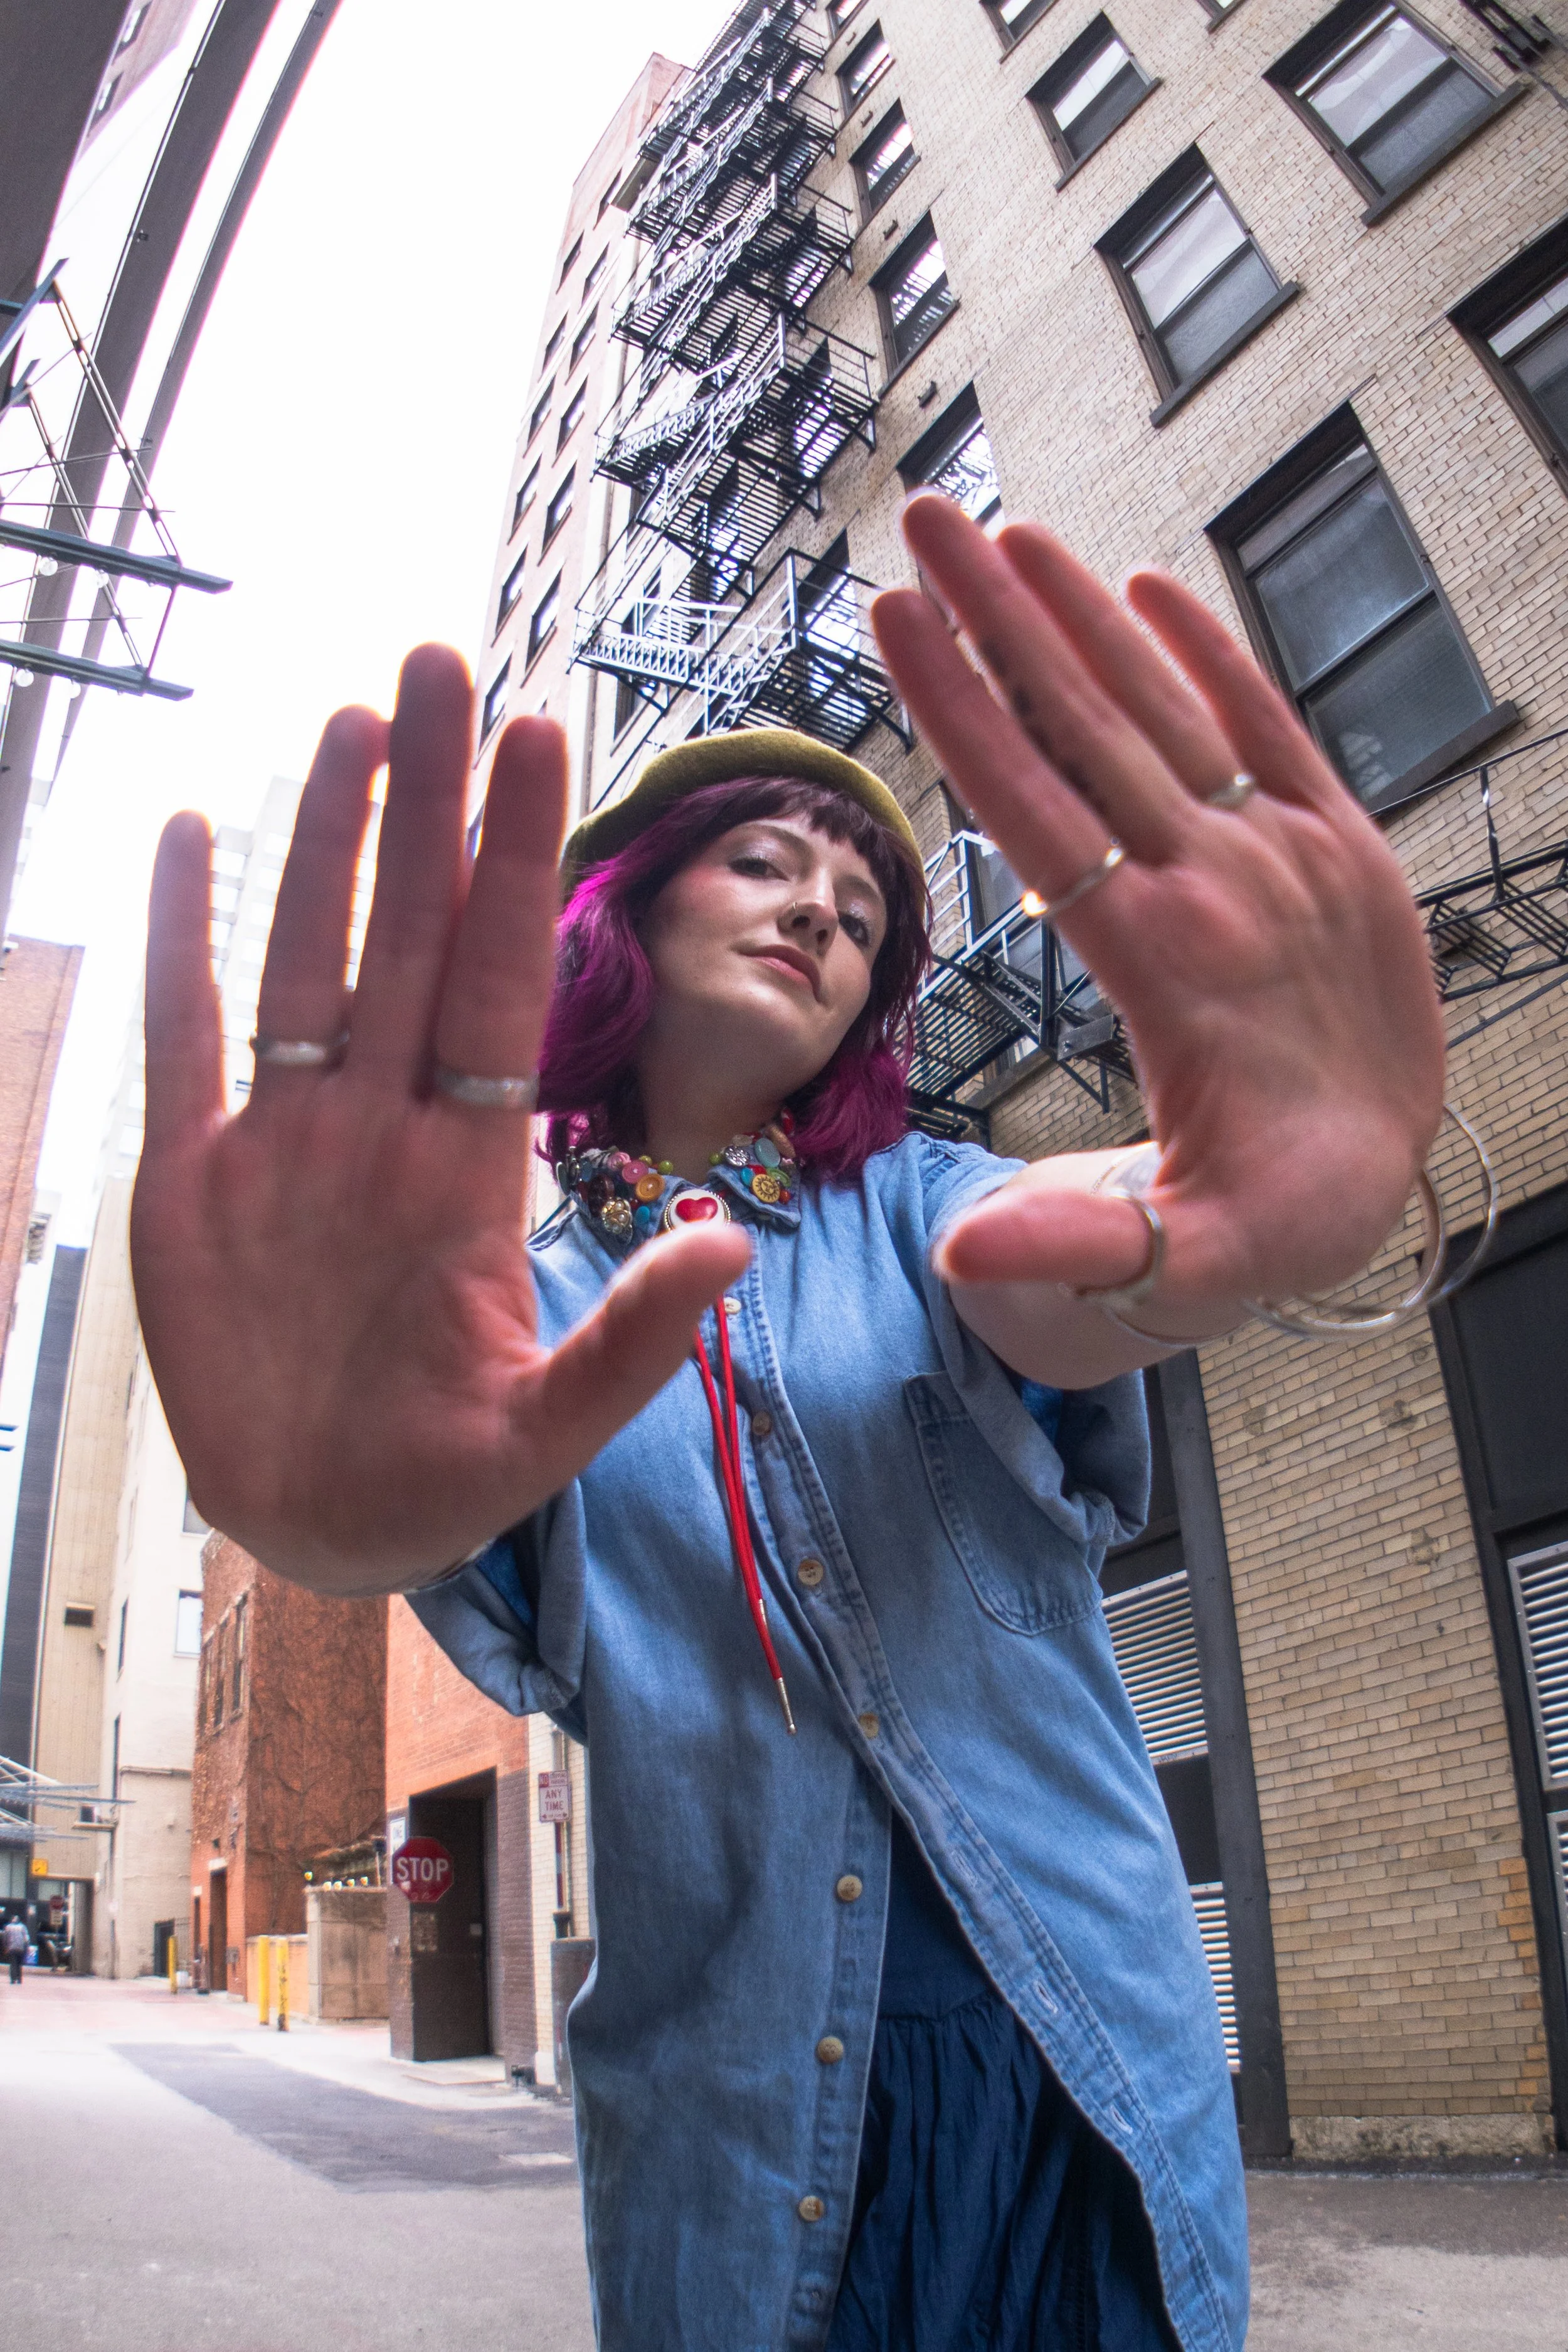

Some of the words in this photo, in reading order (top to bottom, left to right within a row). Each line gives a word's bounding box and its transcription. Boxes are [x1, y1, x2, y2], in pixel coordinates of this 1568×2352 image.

[545, 1789, 562, 1799] ANY
[545, 1801, 563, 1811] TIME
[396, 1857, 448, 1882] STOP
